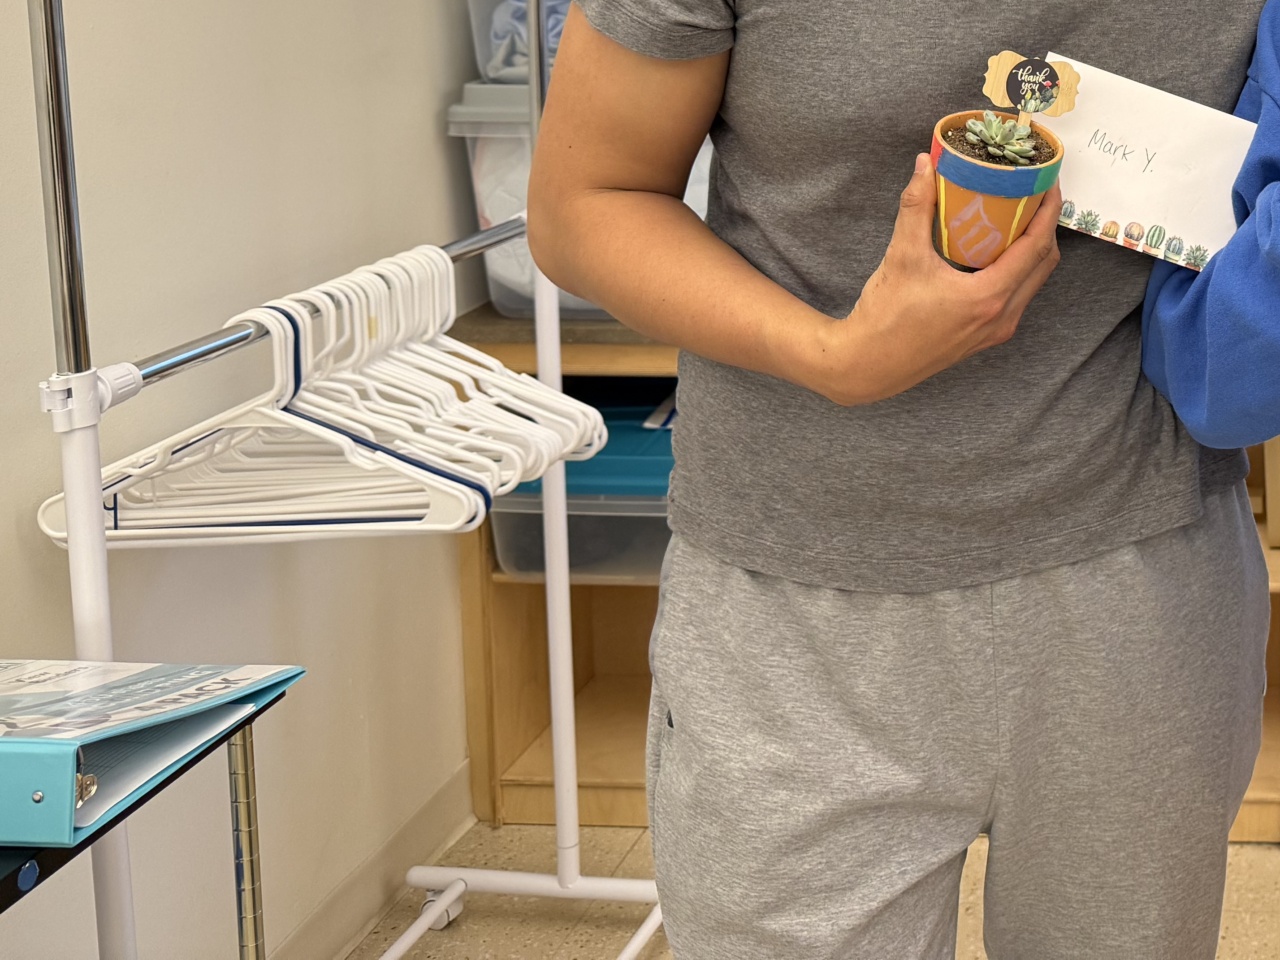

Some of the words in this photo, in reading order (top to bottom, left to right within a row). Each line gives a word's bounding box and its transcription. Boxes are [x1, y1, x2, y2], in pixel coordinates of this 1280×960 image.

[1012, 65, 1050, 85] thank
[1019, 81, 1040, 95] you
[1088, 129, 1135, 161] Mark
[155, 676, 252, 706] PACK
